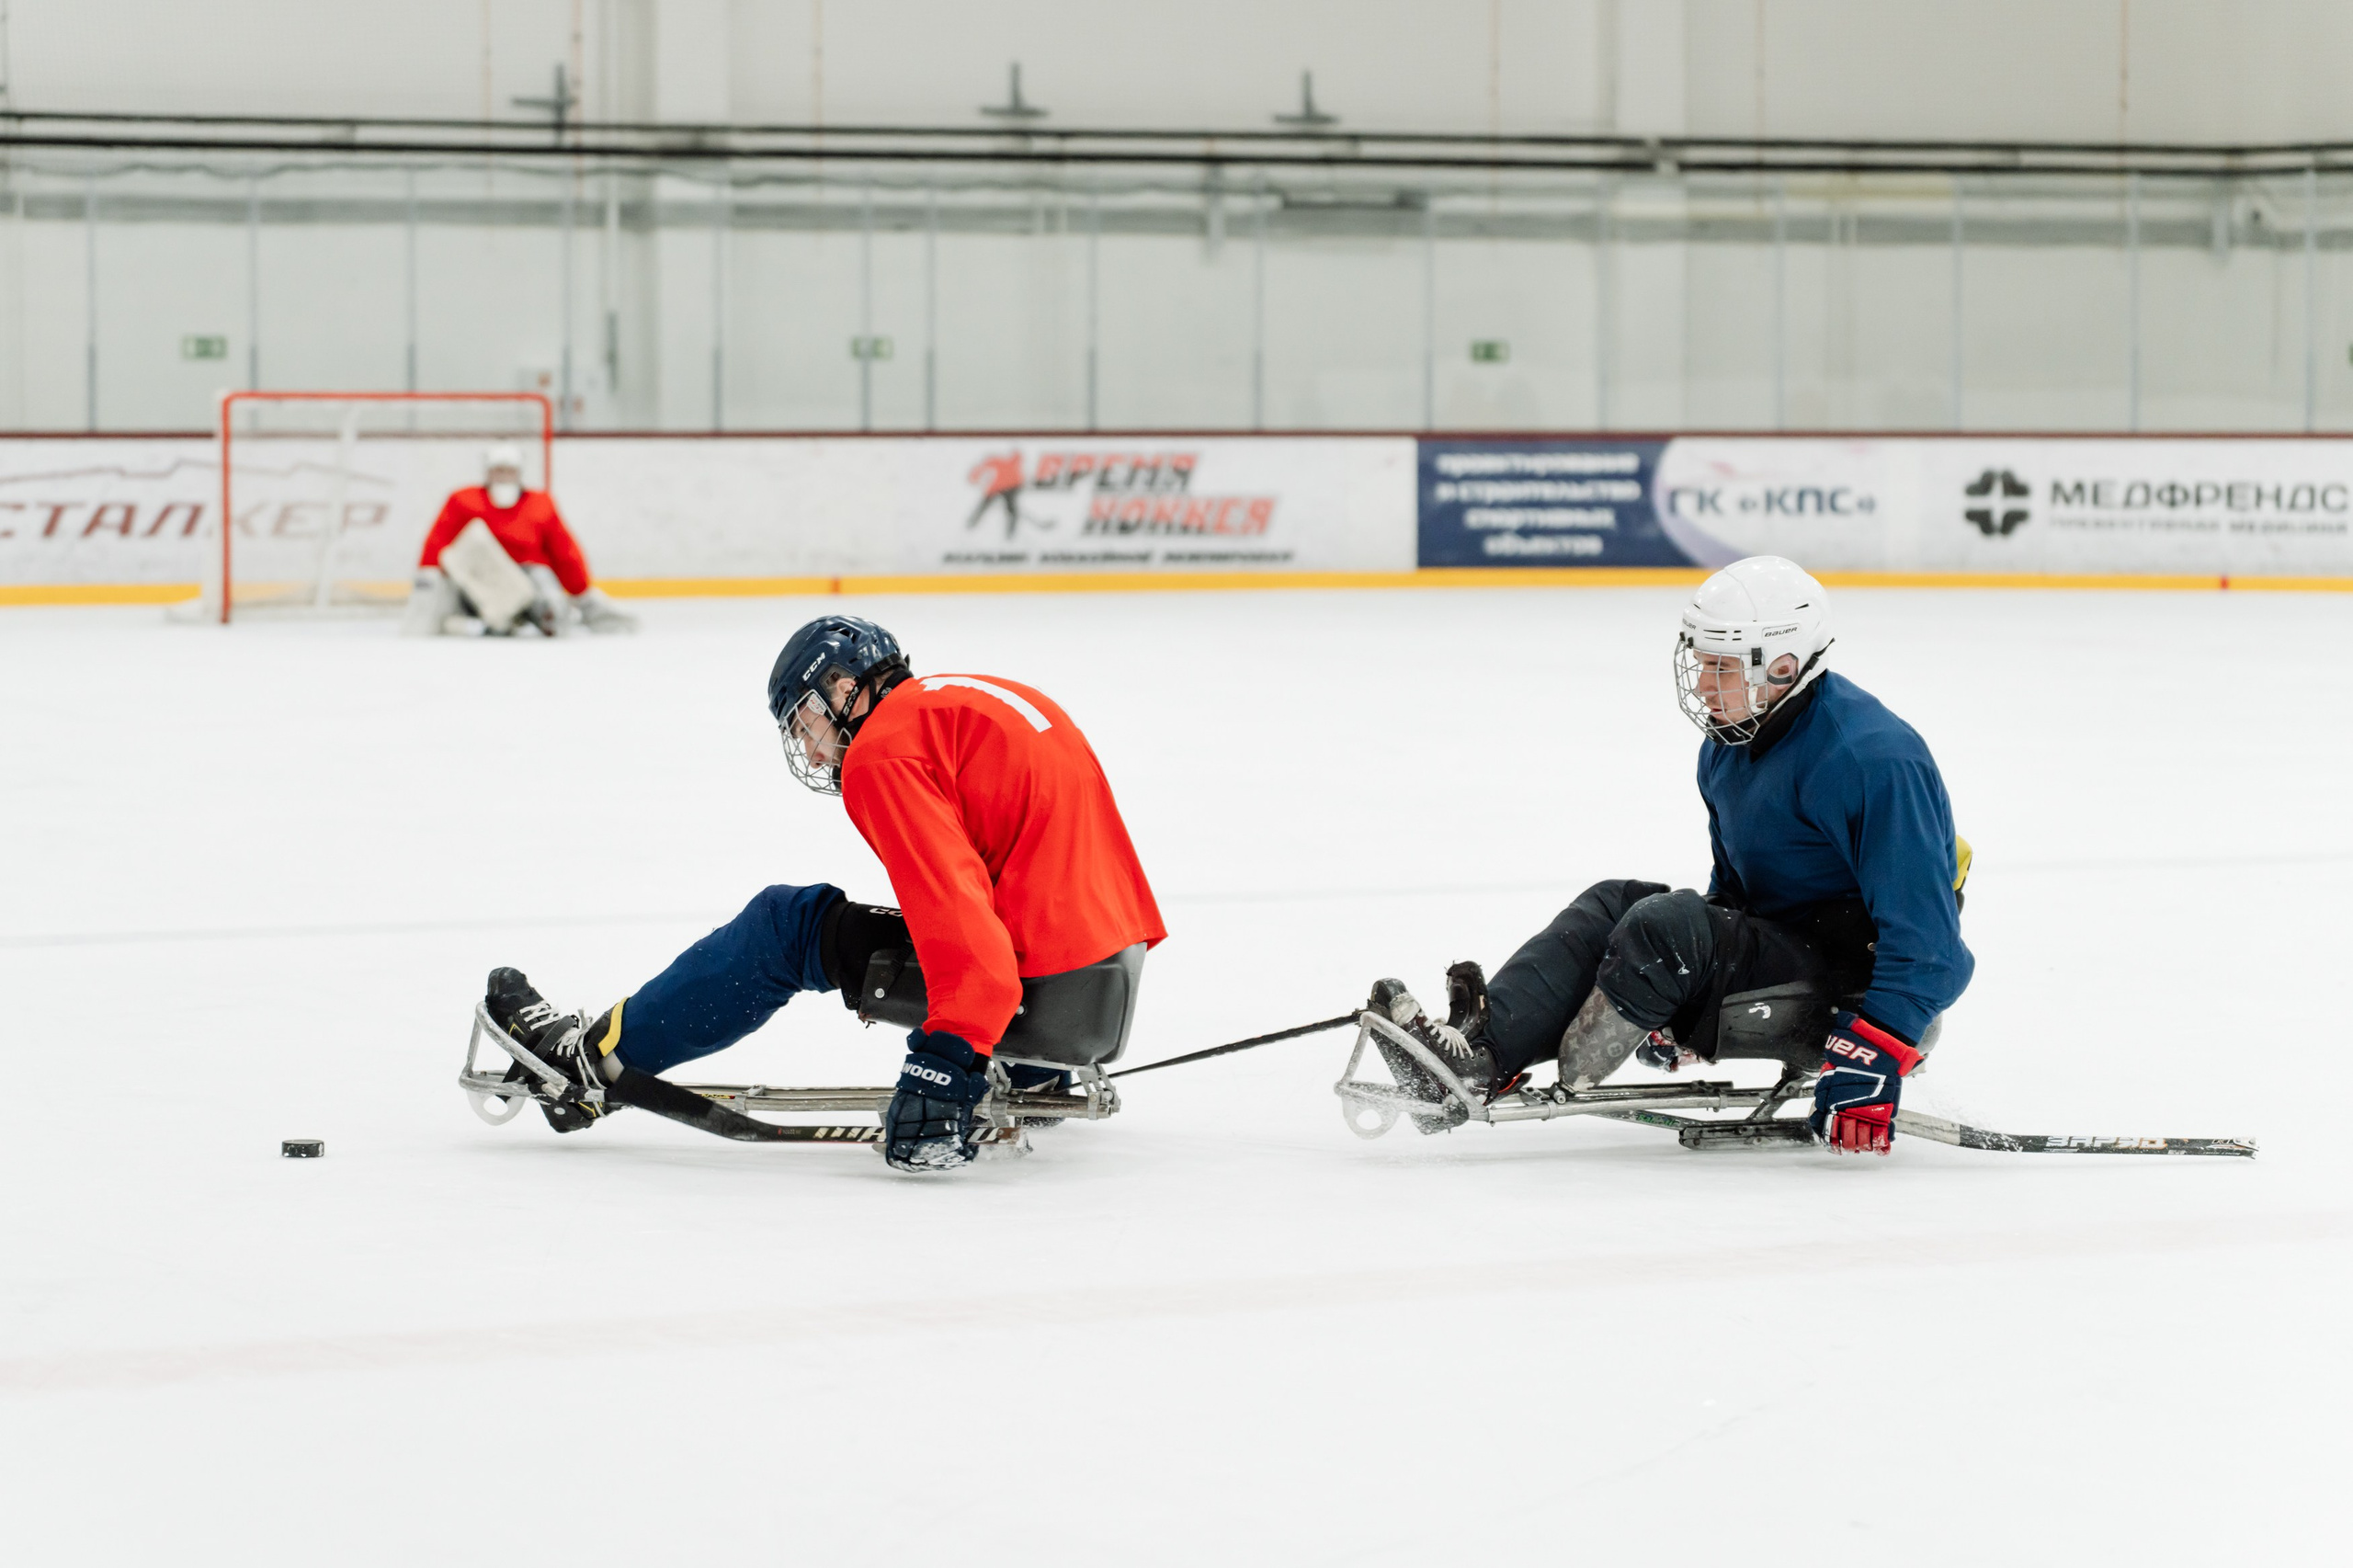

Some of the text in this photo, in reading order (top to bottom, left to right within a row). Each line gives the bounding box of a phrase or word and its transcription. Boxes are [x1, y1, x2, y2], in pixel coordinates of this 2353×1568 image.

[1669, 488, 1723, 514] ГК
[2051, 480, 2349, 513] МЕДФРЕНДС
[1764, 627, 1798, 638] BAUER
[802, 652, 826, 682] CCM
